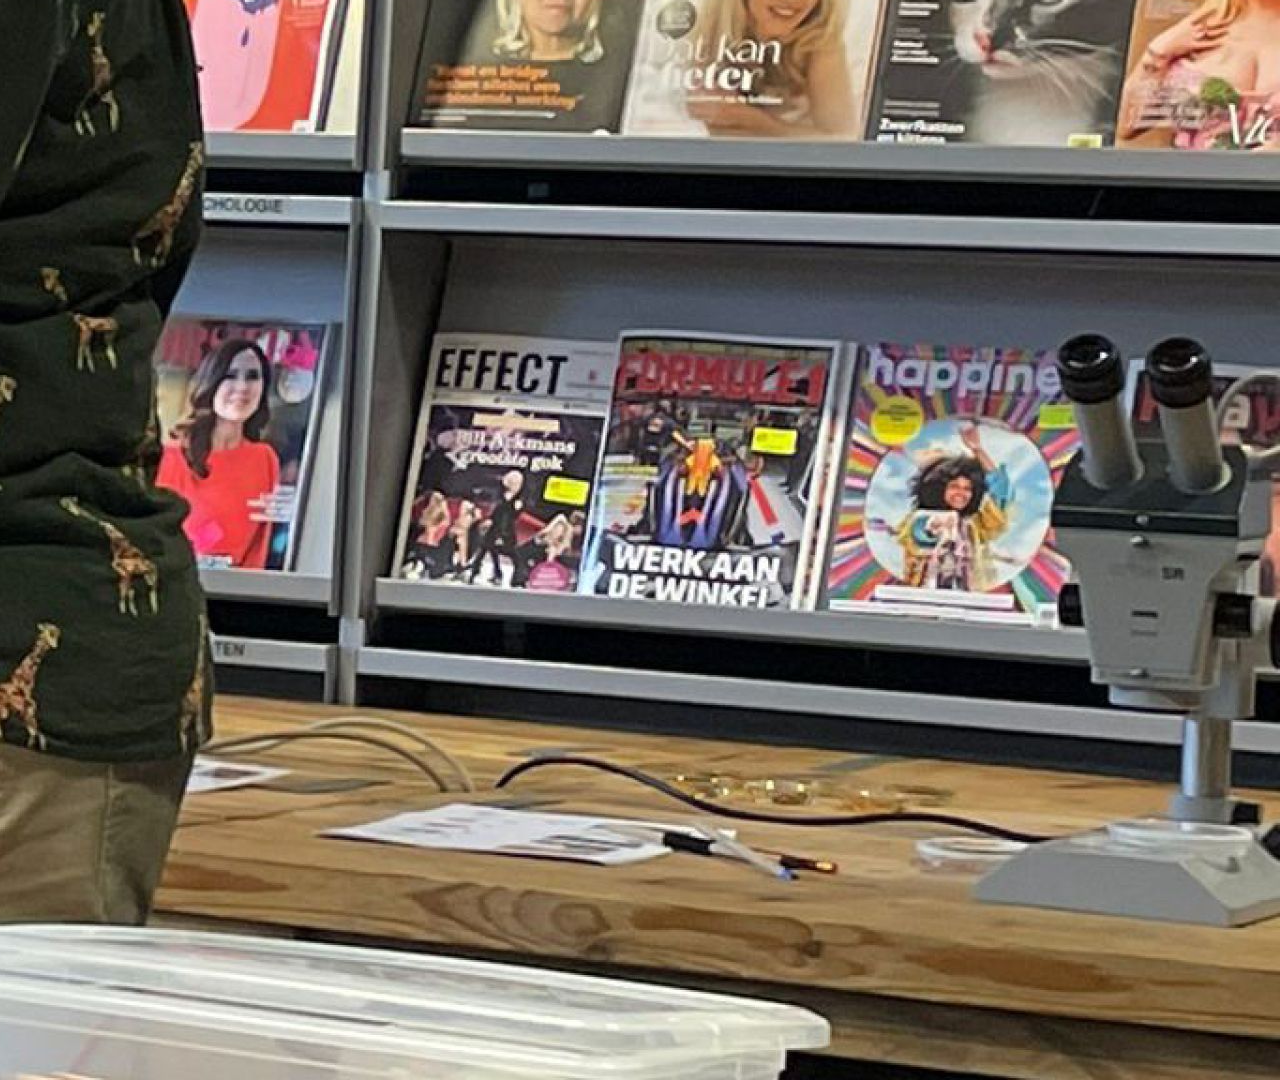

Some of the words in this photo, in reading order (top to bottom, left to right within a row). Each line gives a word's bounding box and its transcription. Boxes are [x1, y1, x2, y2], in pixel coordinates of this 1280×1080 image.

[435, 348, 569, 395] EFFECT
[613, 544, 704, 577] WERK
[710, 550, 780, 581] AAN
[607, 574, 652, 600] DE
